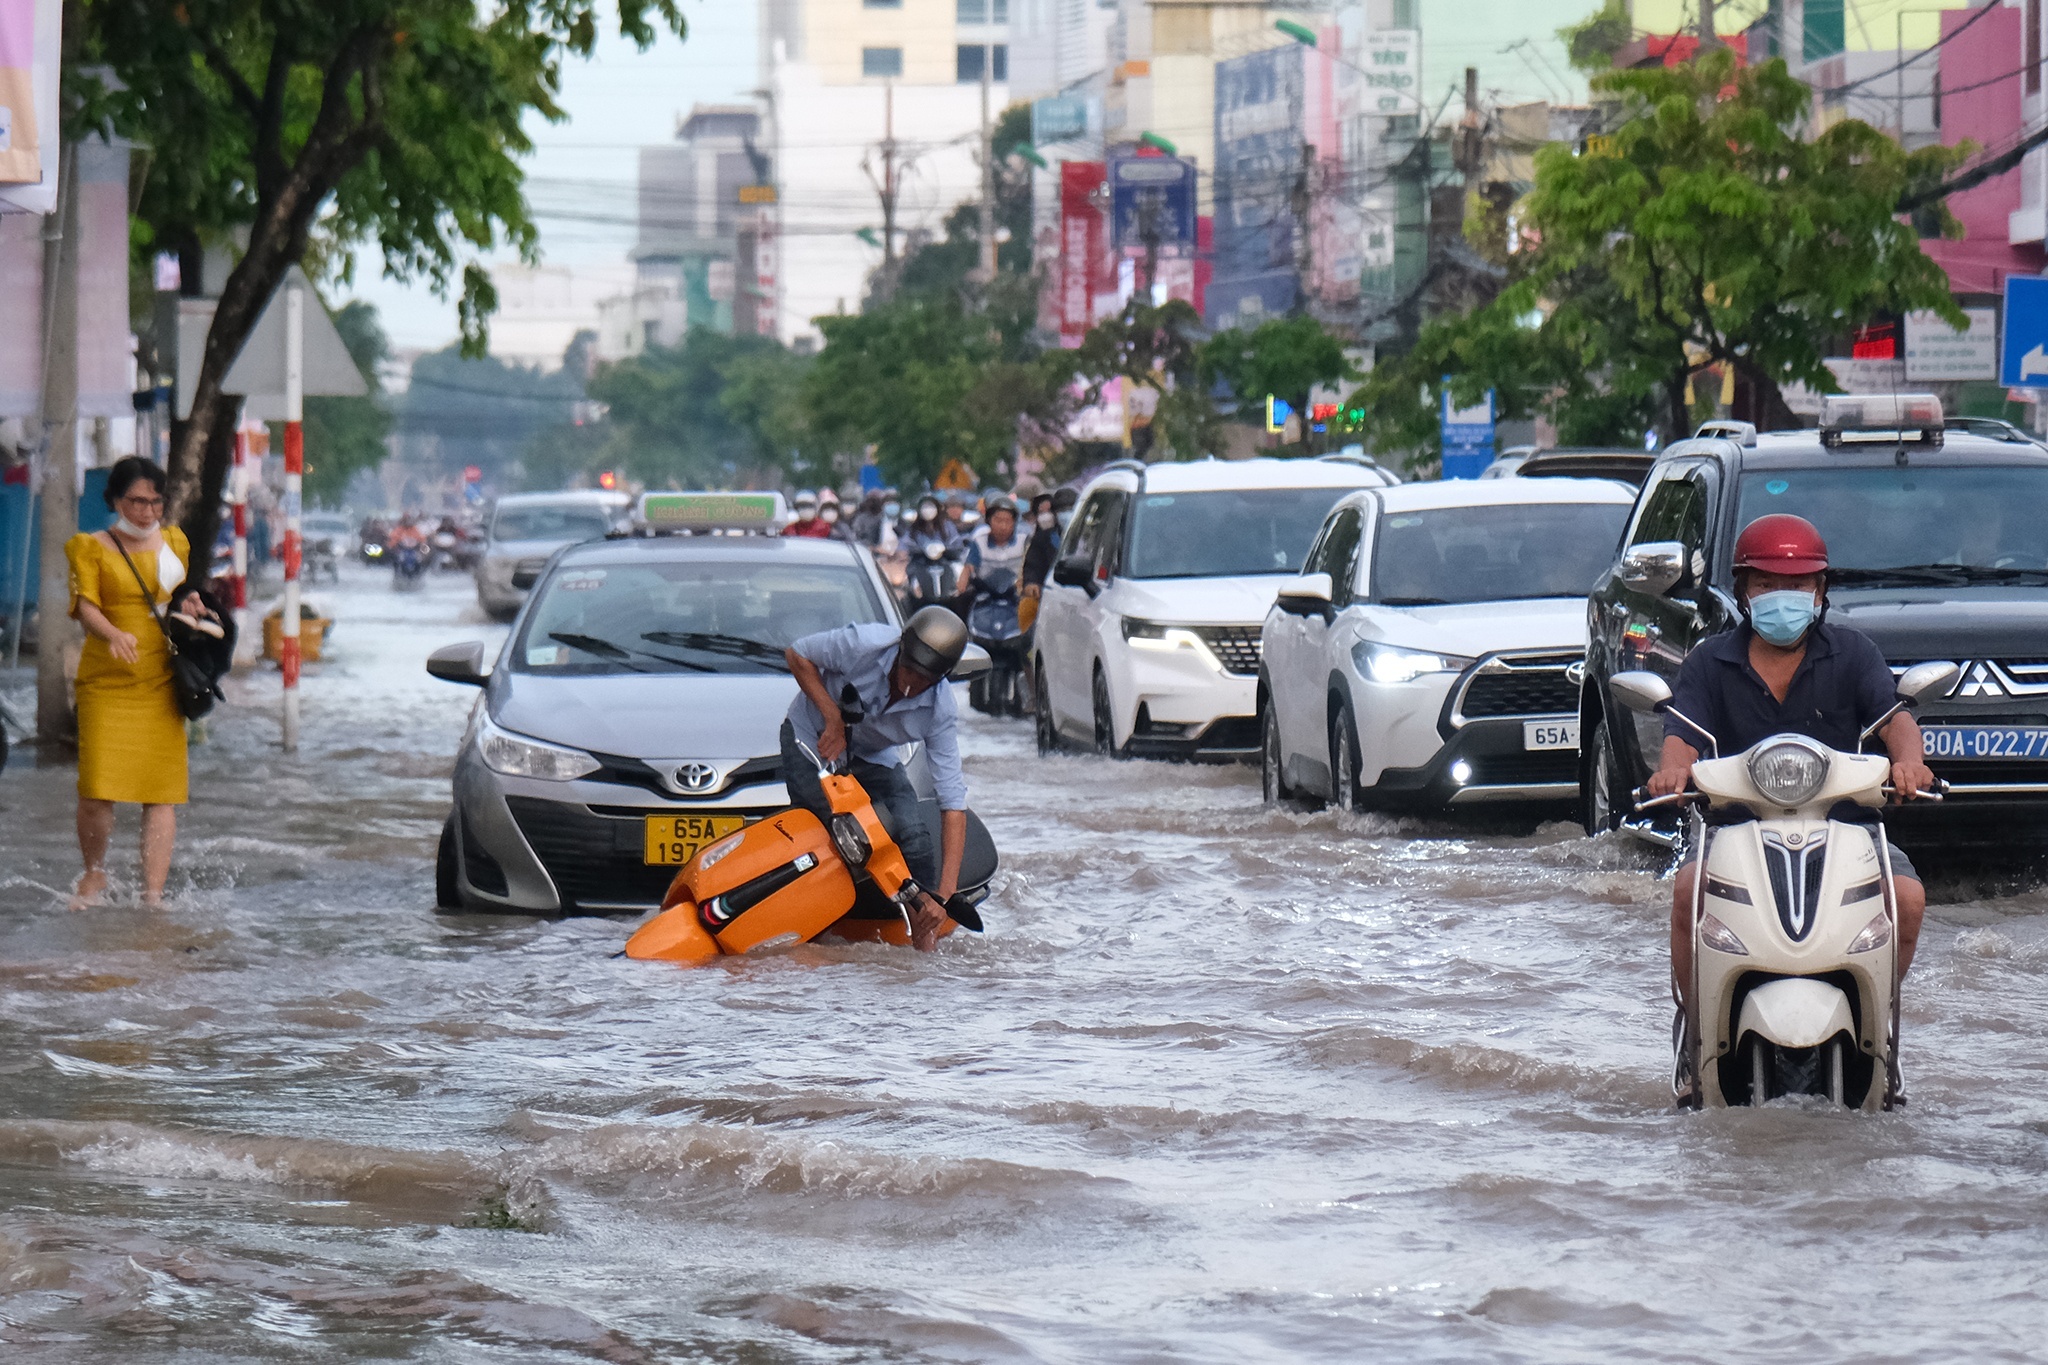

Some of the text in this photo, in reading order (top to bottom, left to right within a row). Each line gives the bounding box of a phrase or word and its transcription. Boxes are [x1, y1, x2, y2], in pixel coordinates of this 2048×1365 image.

[1535, 727, 1579, 745] 65A-
[1921, 730, 2048, 757] 80A-022.77
[674, 819, 716, 839] 65A
